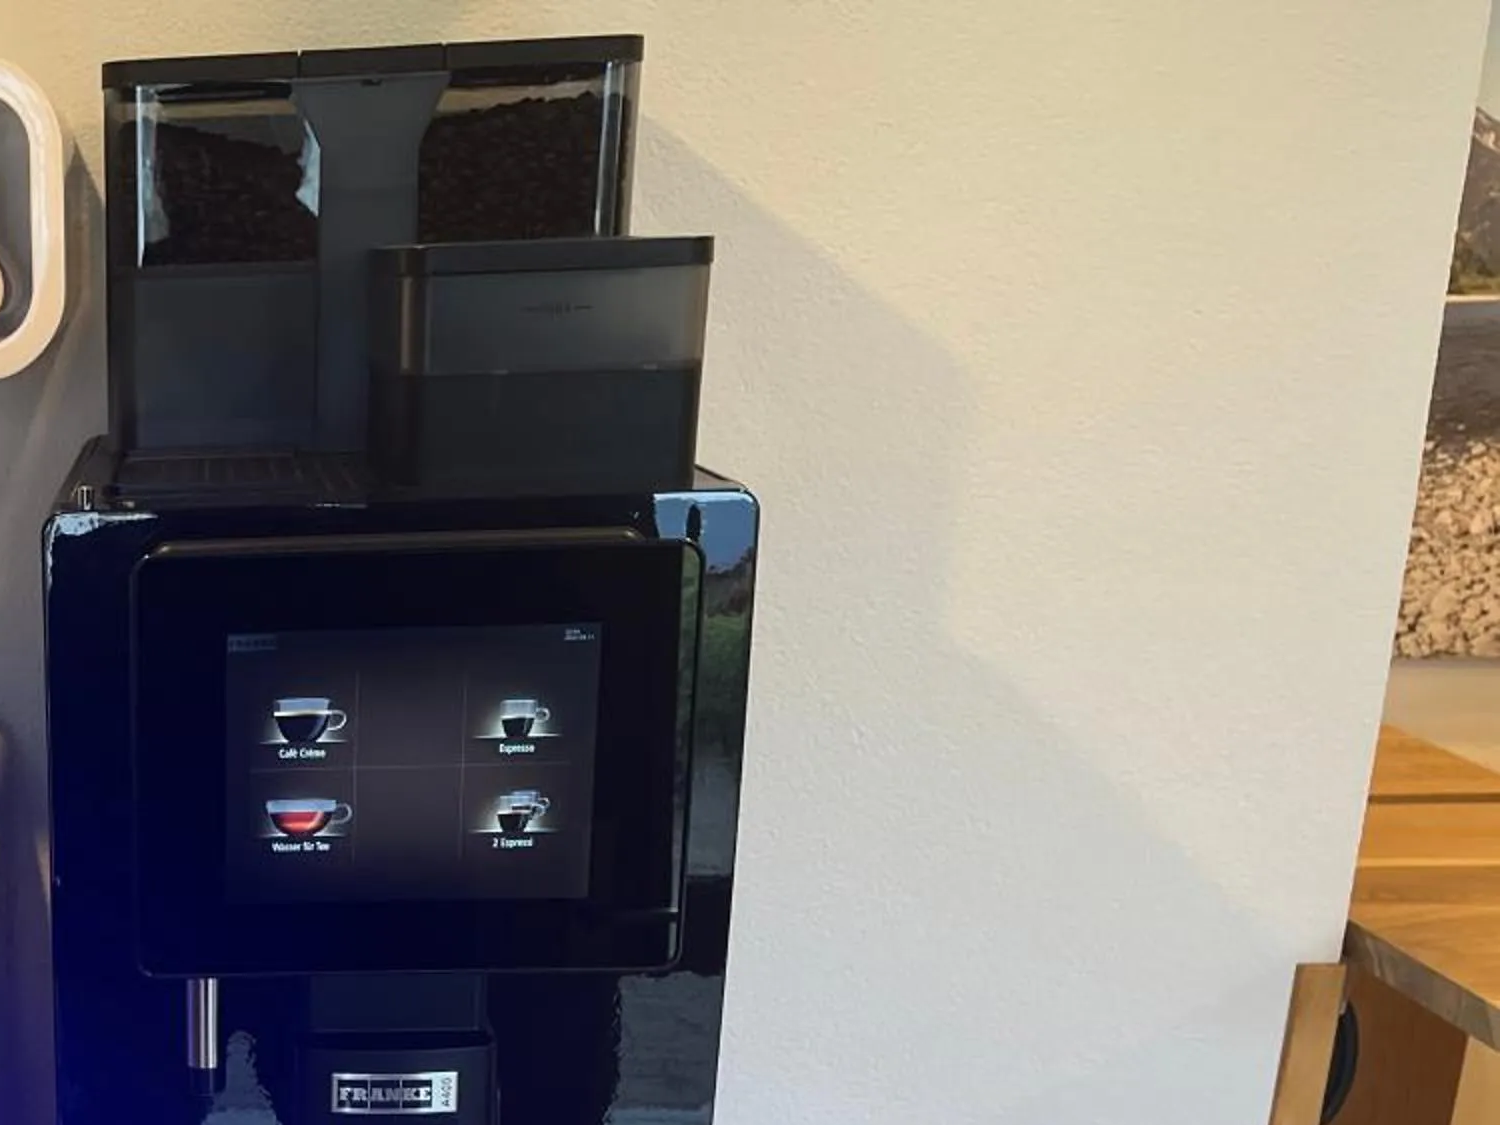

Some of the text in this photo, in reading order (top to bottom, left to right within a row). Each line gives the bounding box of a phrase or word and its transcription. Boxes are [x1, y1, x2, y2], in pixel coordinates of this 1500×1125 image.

[499, 743, 535, 754] Espresso
[271, 840, 330, 852] Wasser für Tee
[492, 838, 499, 848] 2
[338, 1087, 431, 1102] FRANKE
